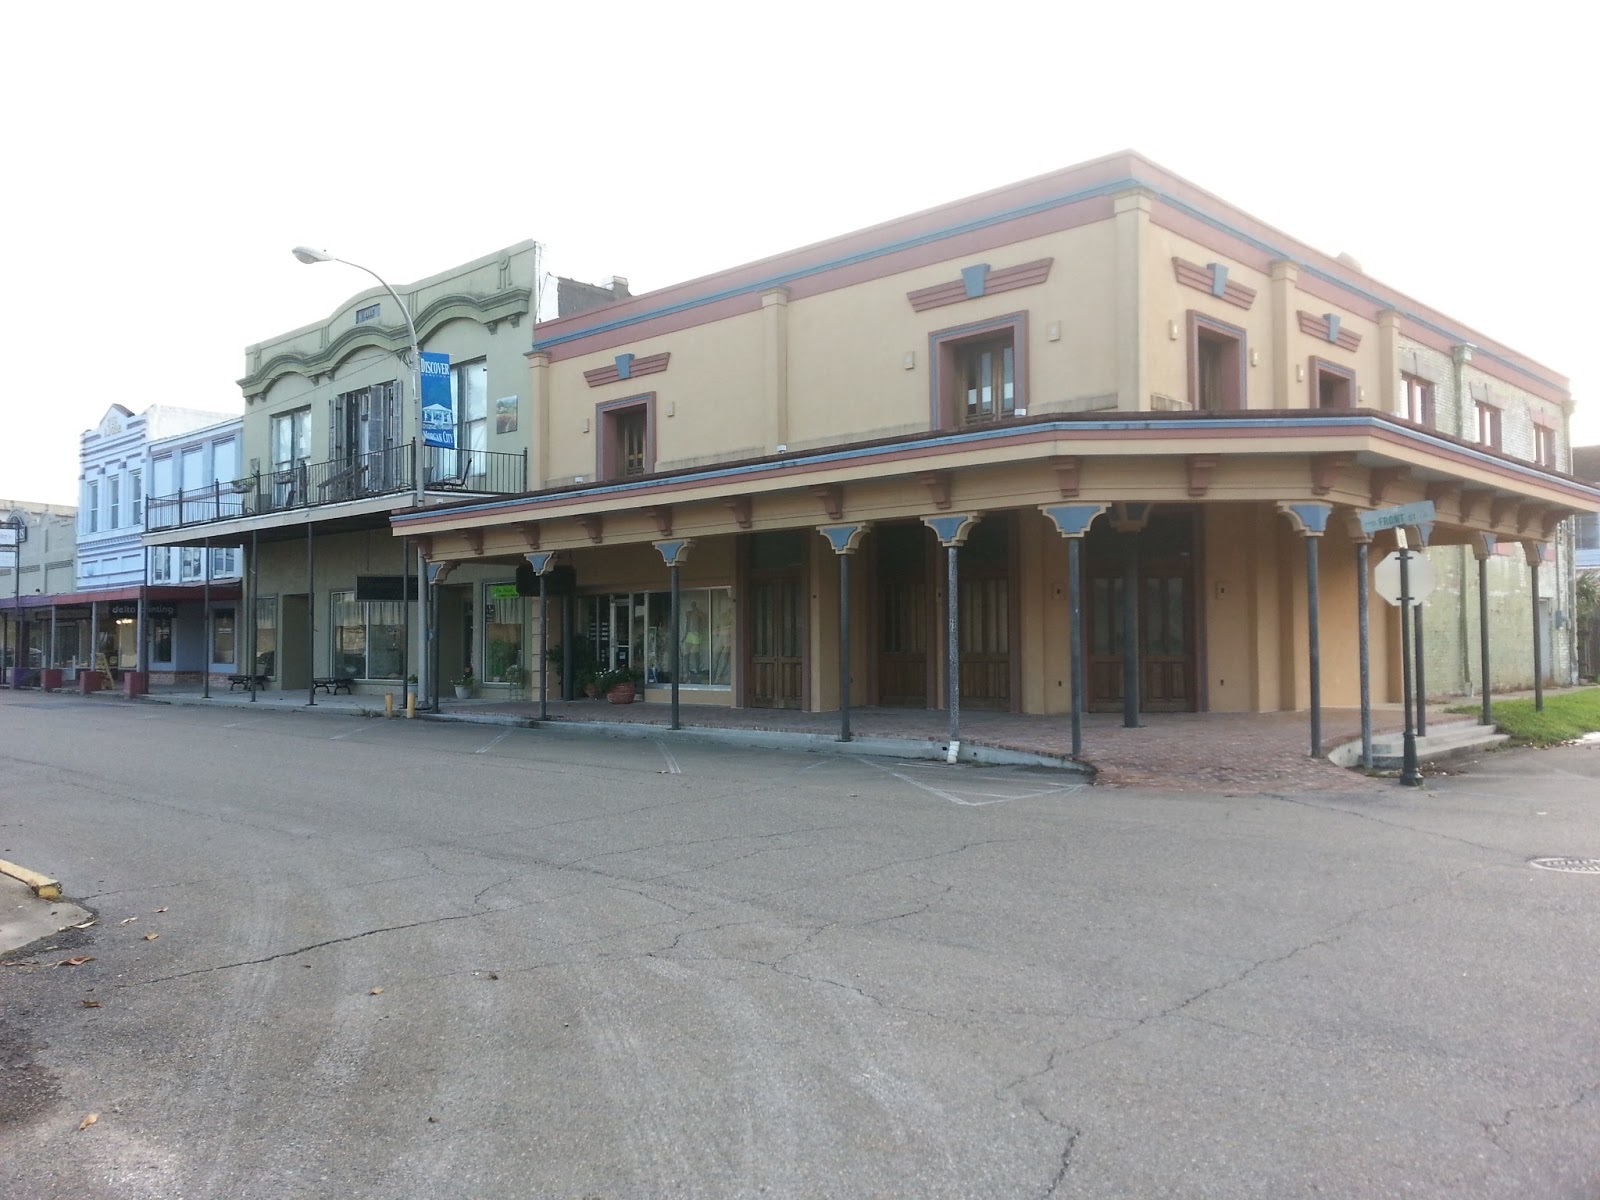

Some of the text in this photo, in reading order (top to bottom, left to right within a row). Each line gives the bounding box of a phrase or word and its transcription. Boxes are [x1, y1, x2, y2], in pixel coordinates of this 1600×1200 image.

[421, 358, 449, 375] DISCOVER
[423, 430, 453, 443] MORGAN CITY
[1379, 514, 1404, 526] FRONT
[112, 605, 174, 614] delta pinting
